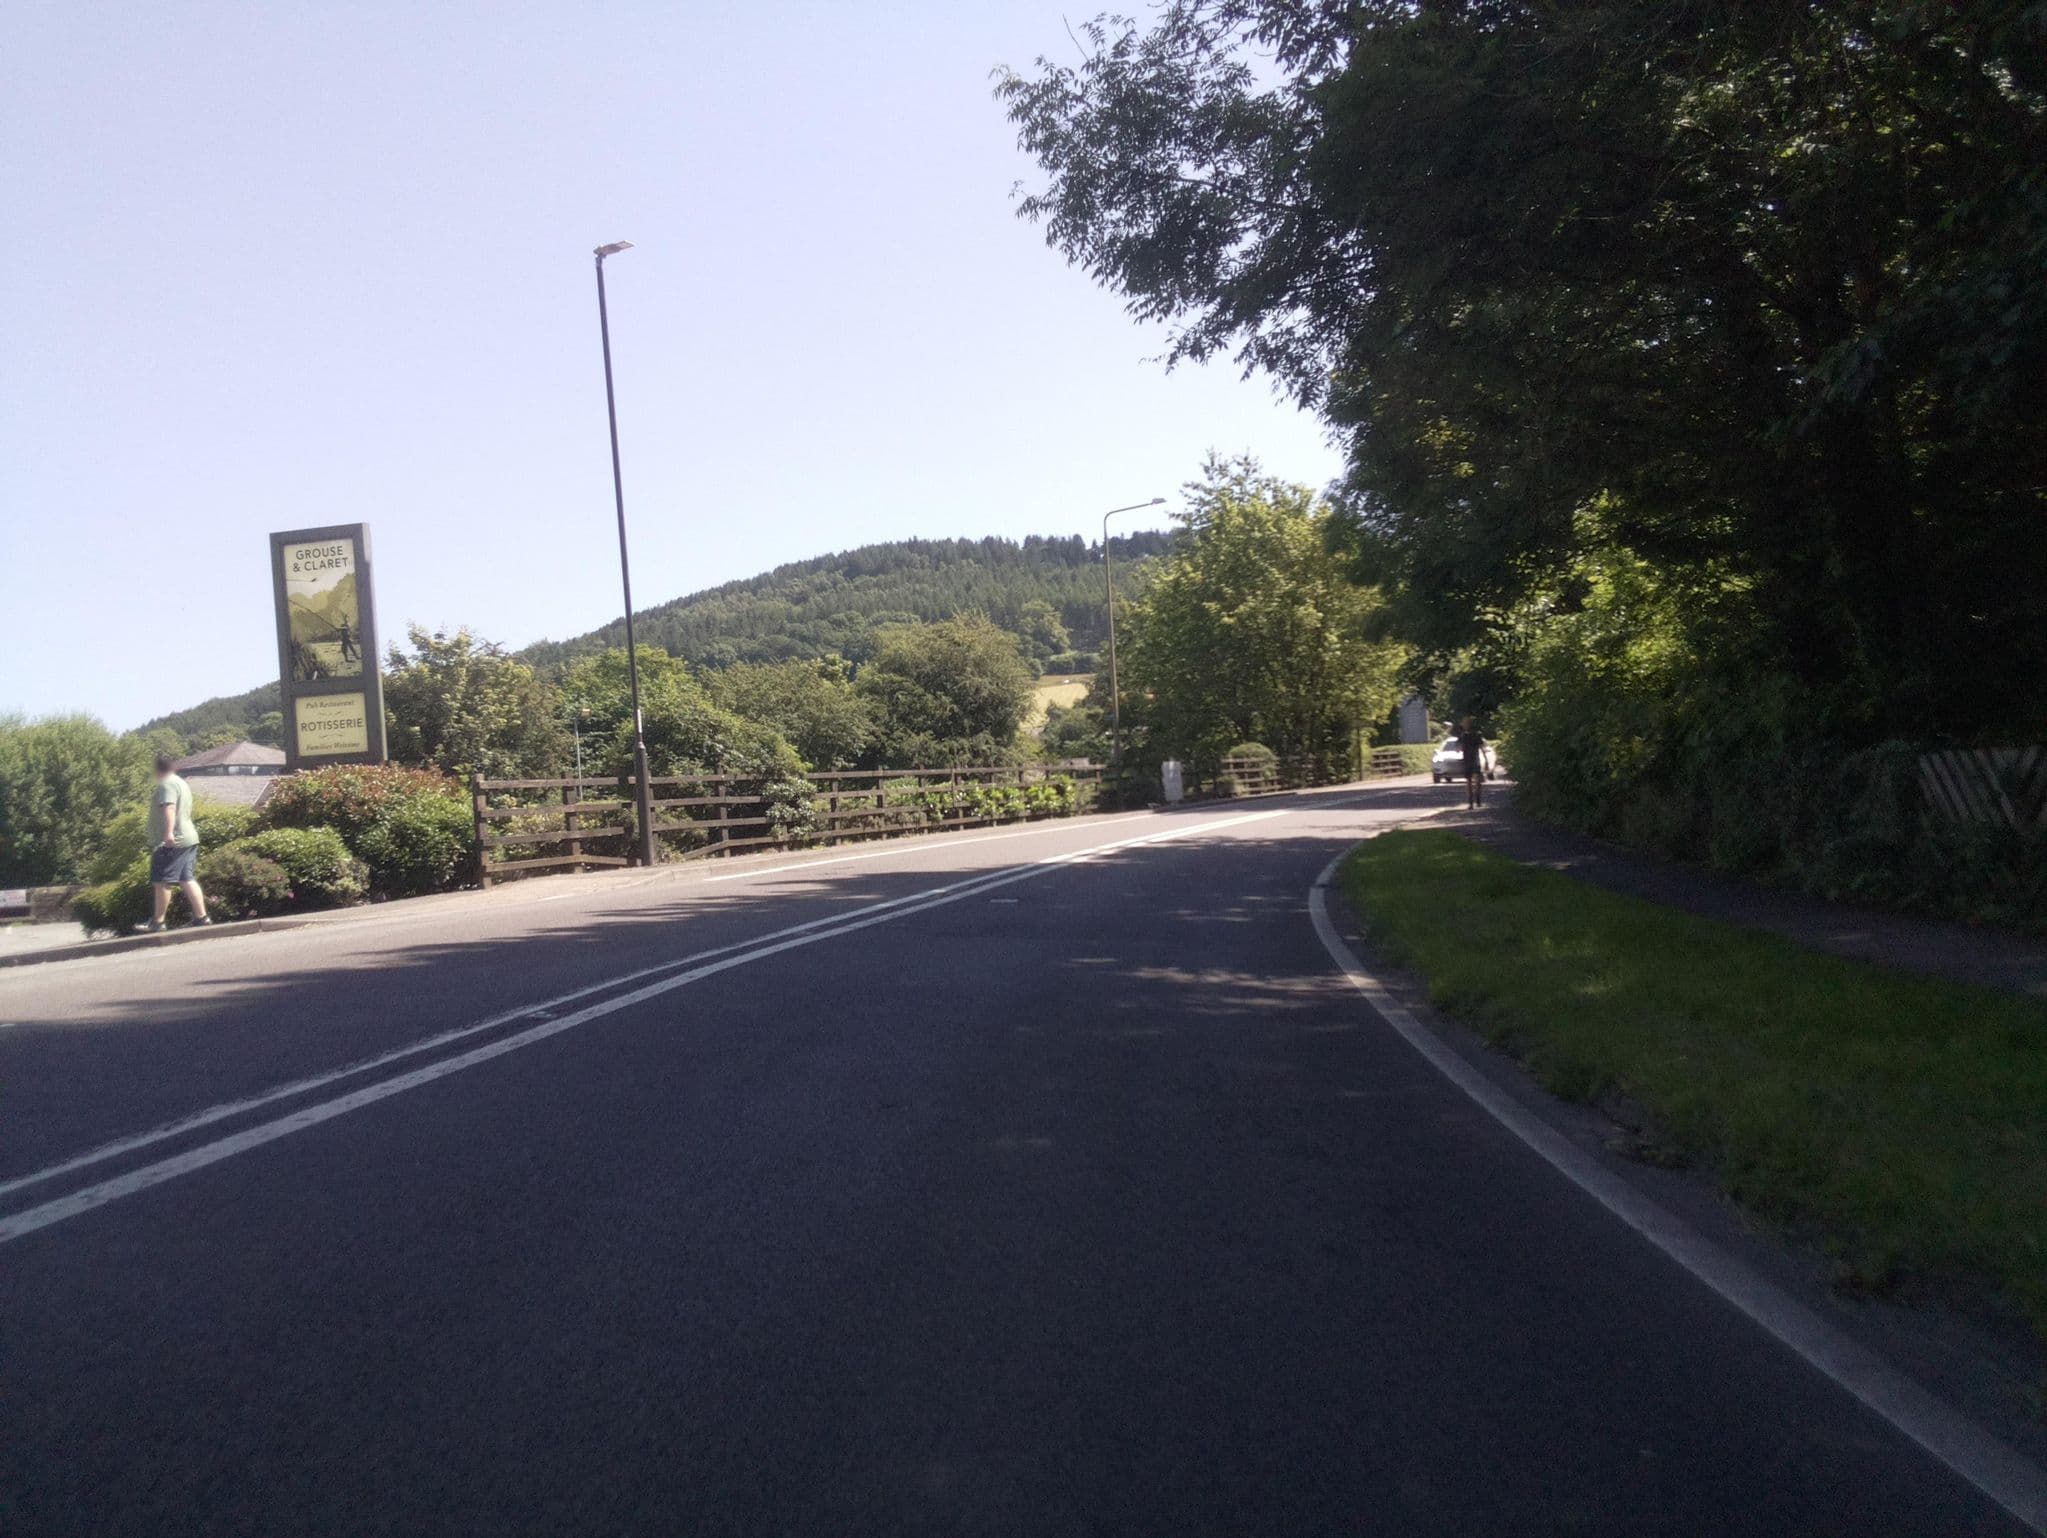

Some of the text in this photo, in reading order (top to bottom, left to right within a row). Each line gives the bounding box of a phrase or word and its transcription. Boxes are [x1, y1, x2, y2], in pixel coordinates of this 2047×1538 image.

[296, 546, 343, 560] GROUSE
[293, 558, 348, 572] & CLARET
[301, 718, 364, 732] ROTISSERIE
